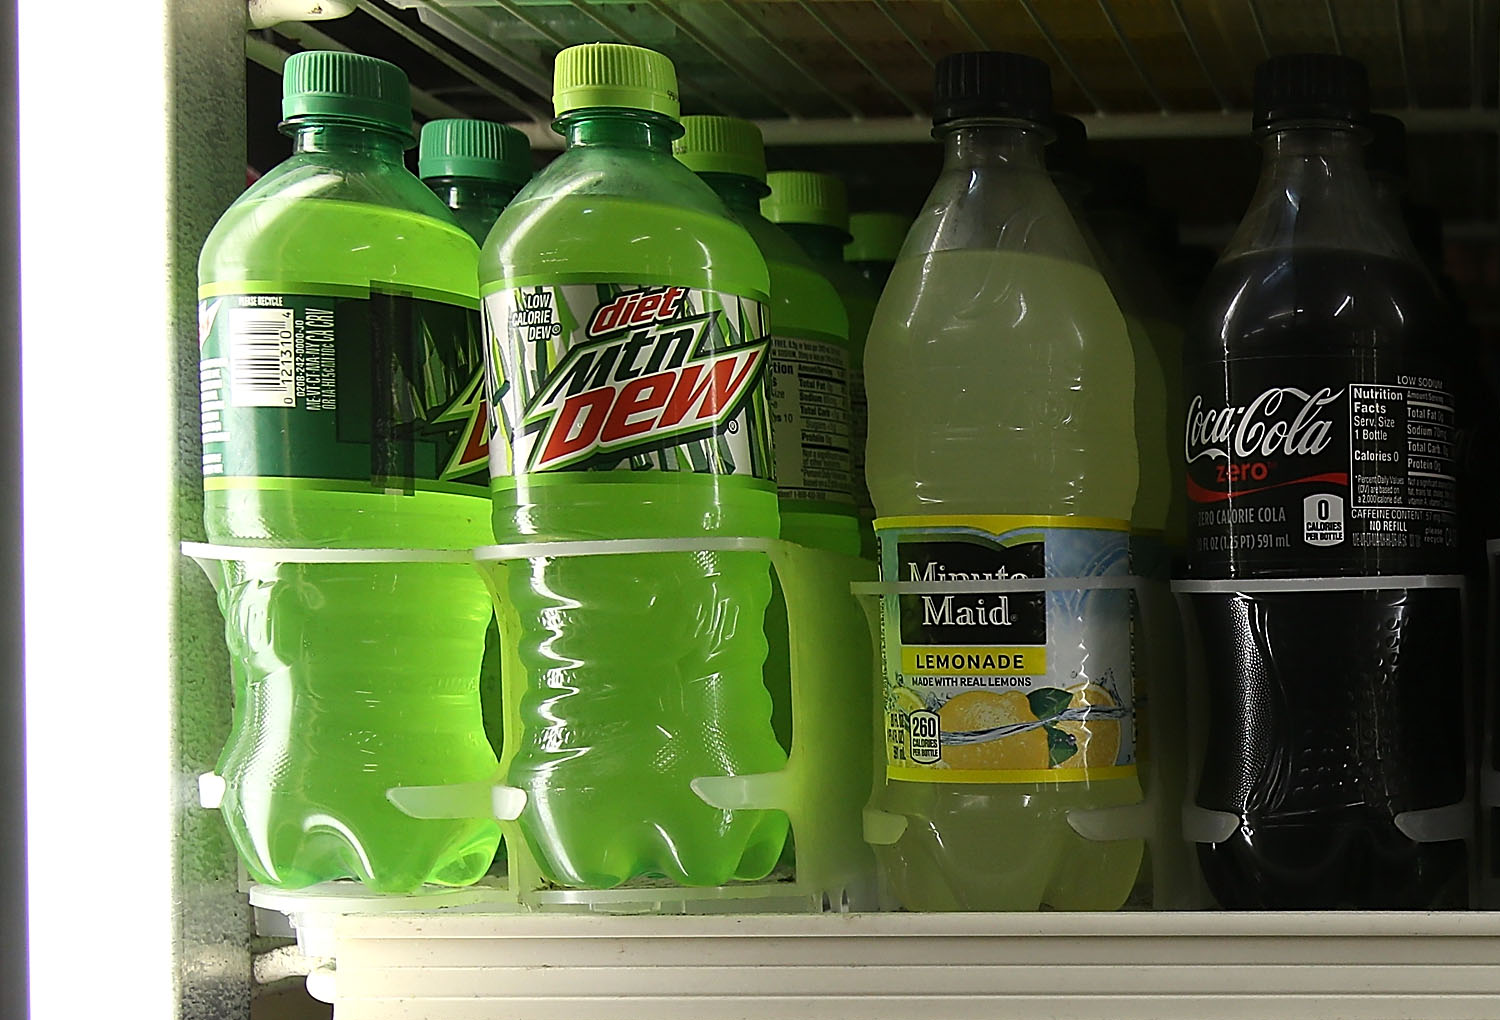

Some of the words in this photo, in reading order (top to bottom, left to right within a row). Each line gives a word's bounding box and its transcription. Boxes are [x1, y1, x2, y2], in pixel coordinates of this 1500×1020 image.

[527, 293, 550, 309] LOW
[304, 308, 334, 328] CRV
[512, 309, 552, 326] CALORIE
[591, 287, 685, 337] diet
[528, 325, 552, 341] DEW
[543, 323, 698, 407] Mtn
[1397, 375, 1417, 386] LOW
[1353, 387, 1403, 401] Nutrition
[540, 350, 760, 464] DEW
[1353, 402, 1387, 414] Facts
[1406, 407, 1426, 419] Total
[1426, 409, 1437, 421] Fat
[1185, 387, 1346, 464] Coca-Cola
[1353, 415, 1376, 428] Serv.
[1378, 416, 1396, 428] Size
[1354, 429, 1360, 440] 1
[1362, 428, 1388, 441] Bottle
[1406, 424, 1433, 436] Sodium
[1406, 440, 1426, 452] Total
[1354, 450, 1392, 462] Calories
[1393, 450, 1400, 462] 0
[1215, 461, 1269, 482] zero
[1407, 458, 1433, 470] Protein
[1216, 507, 1255, 525] CALORIE
[1258, 506, 1286, 523] COLA
[1318, 499, 1330, 520] 0
[1351, 509, 1390, 520] CAFFEINE
[1306, 522, 1342, 531] CALORIES
[1369, 520, 1382, 532] NO
[1383, 520, 1408, 532] REFILL
[1240, 534, 1256, 550] PT)
[1257, 534, 1273, 548] 591
[1275, 534, 1292, 548] mL
[921, 595, 1012, 626] Maid
[915, 654, 1025, 670] LEMONADE
[912, 677, 934, 687] MADE
[935, 677, 958, 687] WITH
[960, 677, 987, 687] REAL
[988, 677, 1032, 688] LEMONS
[912, 717, 936, 737] 260
[912, 738, 938, 749] CALORIES
